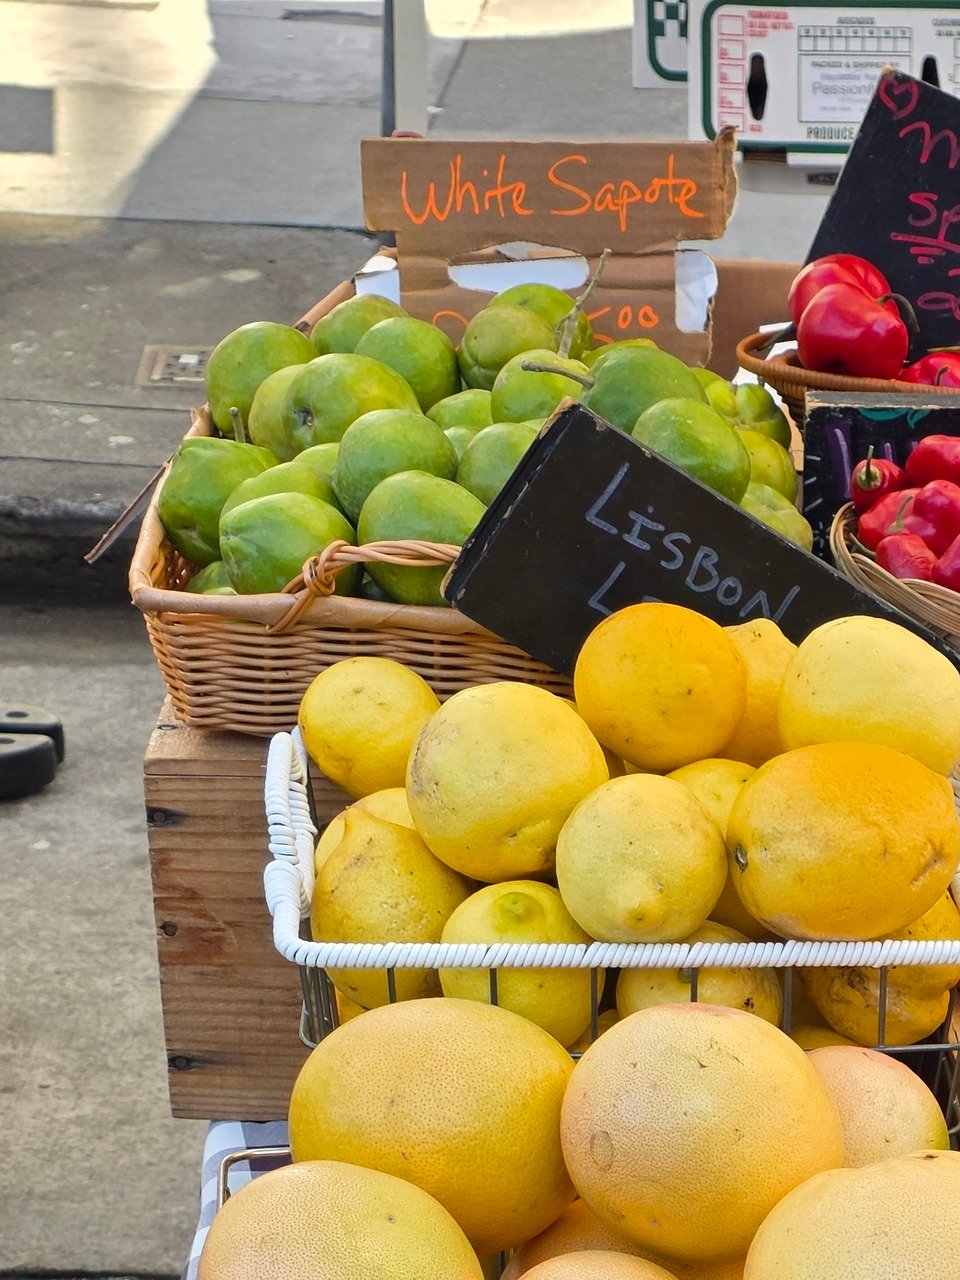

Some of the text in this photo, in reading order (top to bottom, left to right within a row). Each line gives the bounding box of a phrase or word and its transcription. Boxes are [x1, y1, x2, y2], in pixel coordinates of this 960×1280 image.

[812, 81, 876, 95] Passionf
[807, 126, 854, 140] PRODUCE
[401, 153, 705, 232] White Sapote
